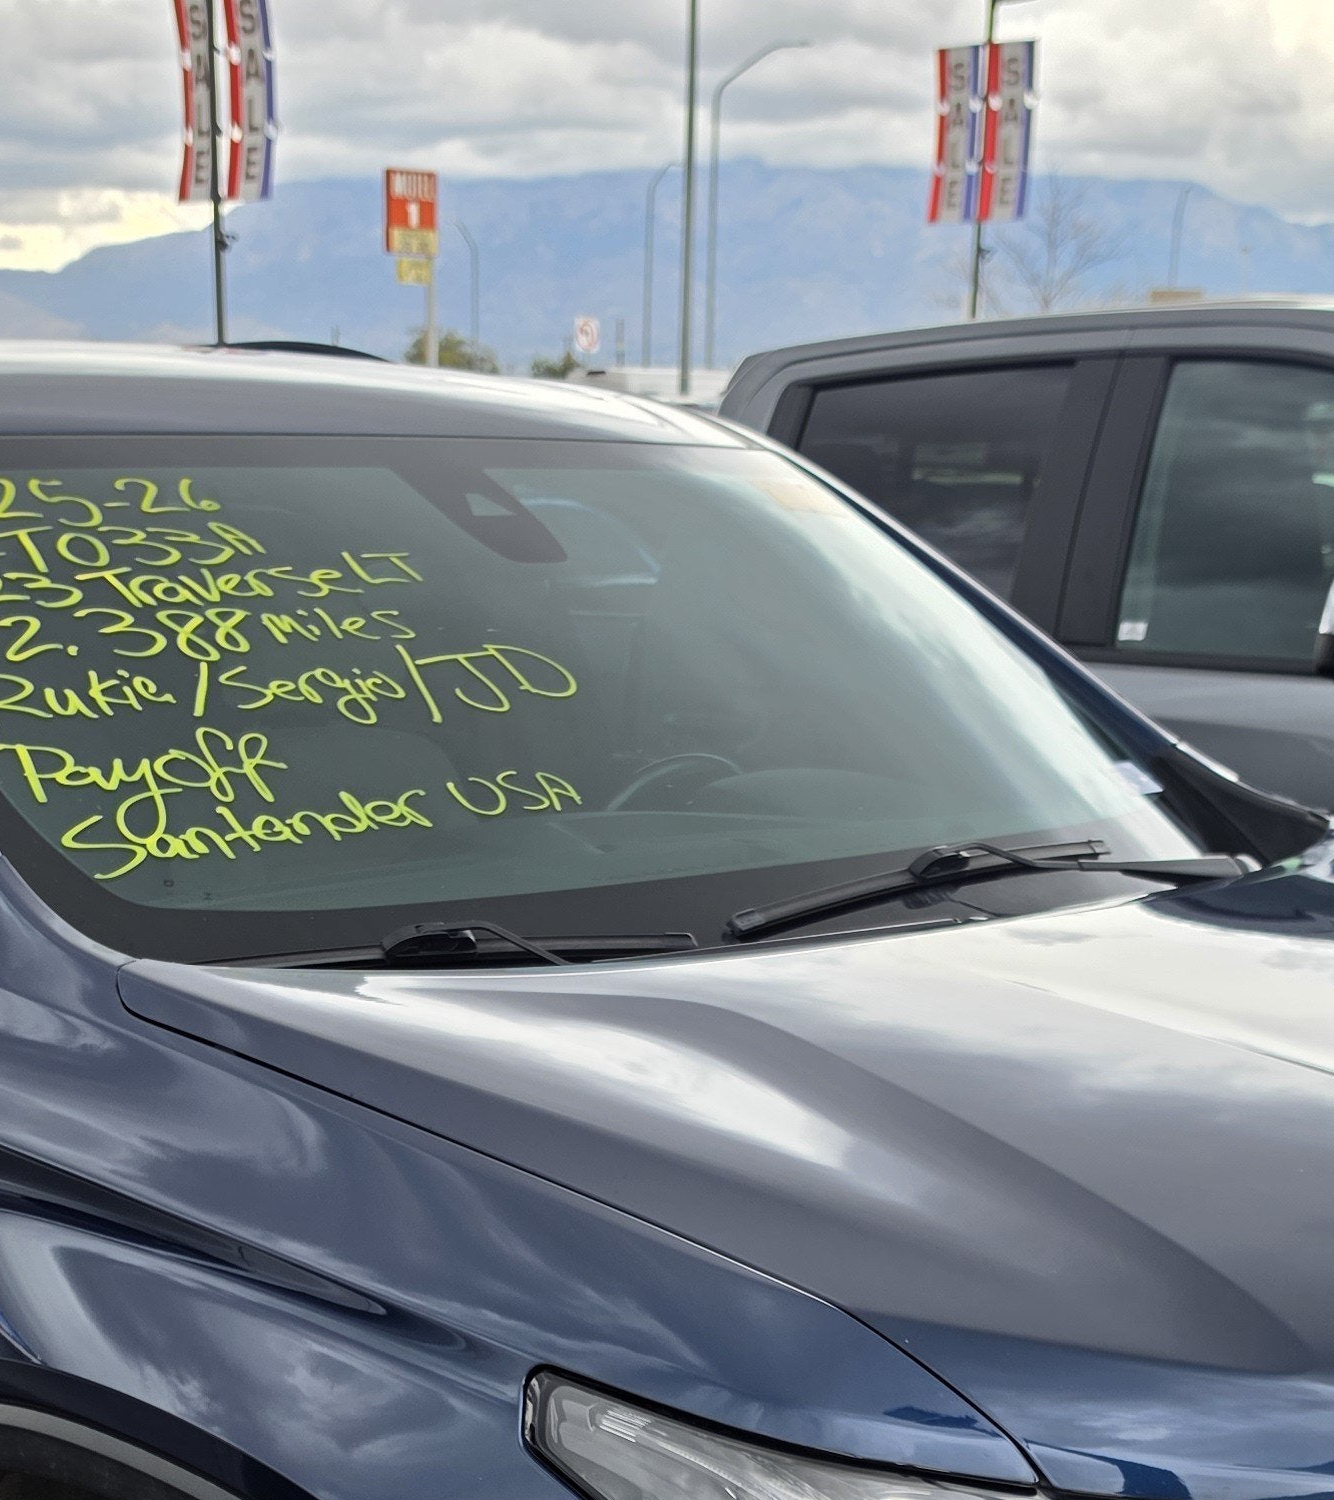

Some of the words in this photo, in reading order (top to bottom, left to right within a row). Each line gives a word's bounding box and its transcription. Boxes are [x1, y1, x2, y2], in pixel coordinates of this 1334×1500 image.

[239, 0, 261, 180] SALE
[75, 566, 365, 608] Traverse
[340, 550, 424, 585] LT
[60, 789, 434, 880] Santander
[445, 770, 583, 816] USA
